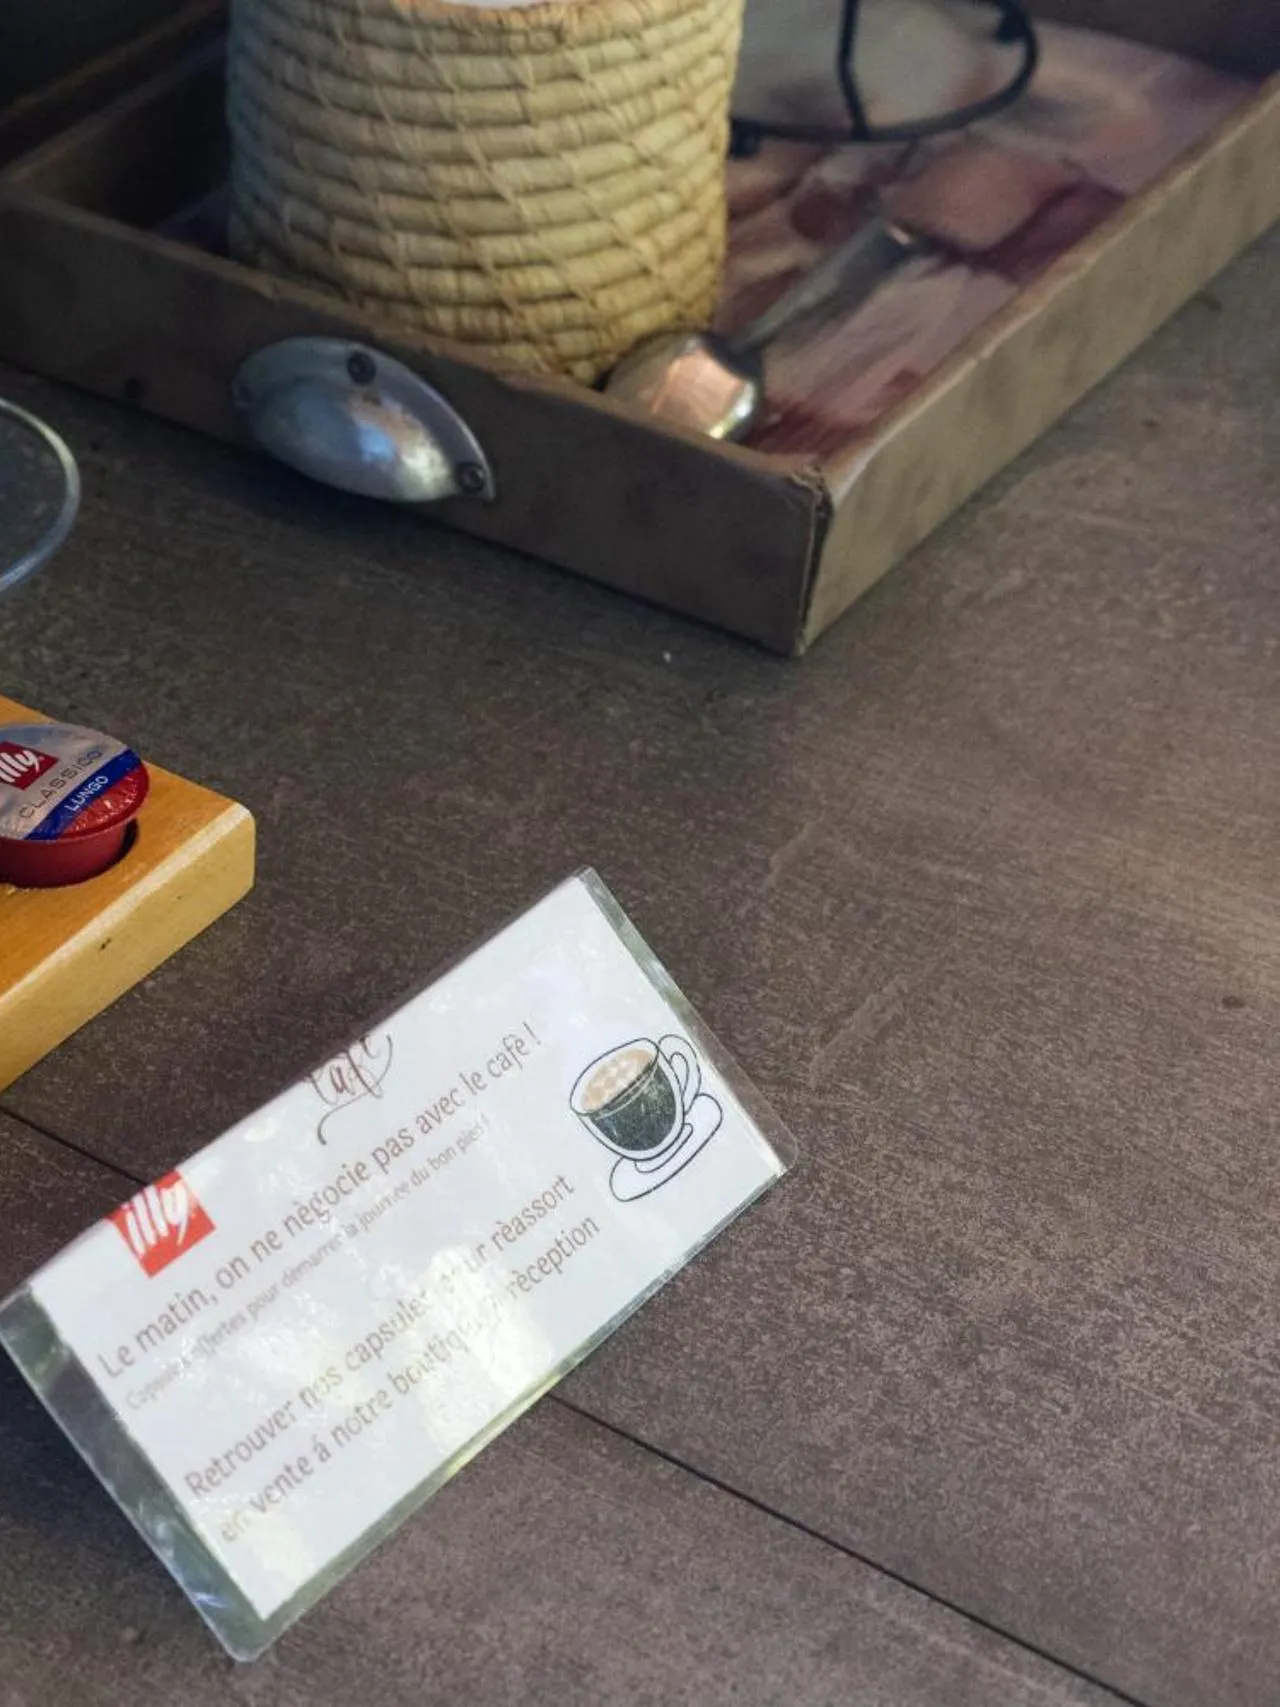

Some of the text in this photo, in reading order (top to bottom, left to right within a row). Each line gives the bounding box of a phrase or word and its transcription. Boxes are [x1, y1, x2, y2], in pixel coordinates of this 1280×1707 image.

[19, 749, 104, 820] CLASSICO
[64, 774, 109, 812] LUNGO
[97, 1344, 136, 1378] Le
[135, 1288, 218, 1353] matin,
[215, 1255, 251, 1290] on
[249, 1229, 284, 1263] ne
[371, 1127, 415, 1175] pas
[415, 1087, 466, 1135] avec
[458, 1071, 488, 1096] le
[521, 1020, 542, 1046] !
[121, 1181, 190, 1256] illy
[246, 1283, 280, 1321] pour
[410, 1166, 431, 1187] du
[426, 1146, 458, 1171] bon
[183, 1400, 298, 1497] Retrouver
[298, 1365, 344, 1410] nos
[248, 1455, 315, 1514] vente
[329, 1387, 393, 1449] notre
